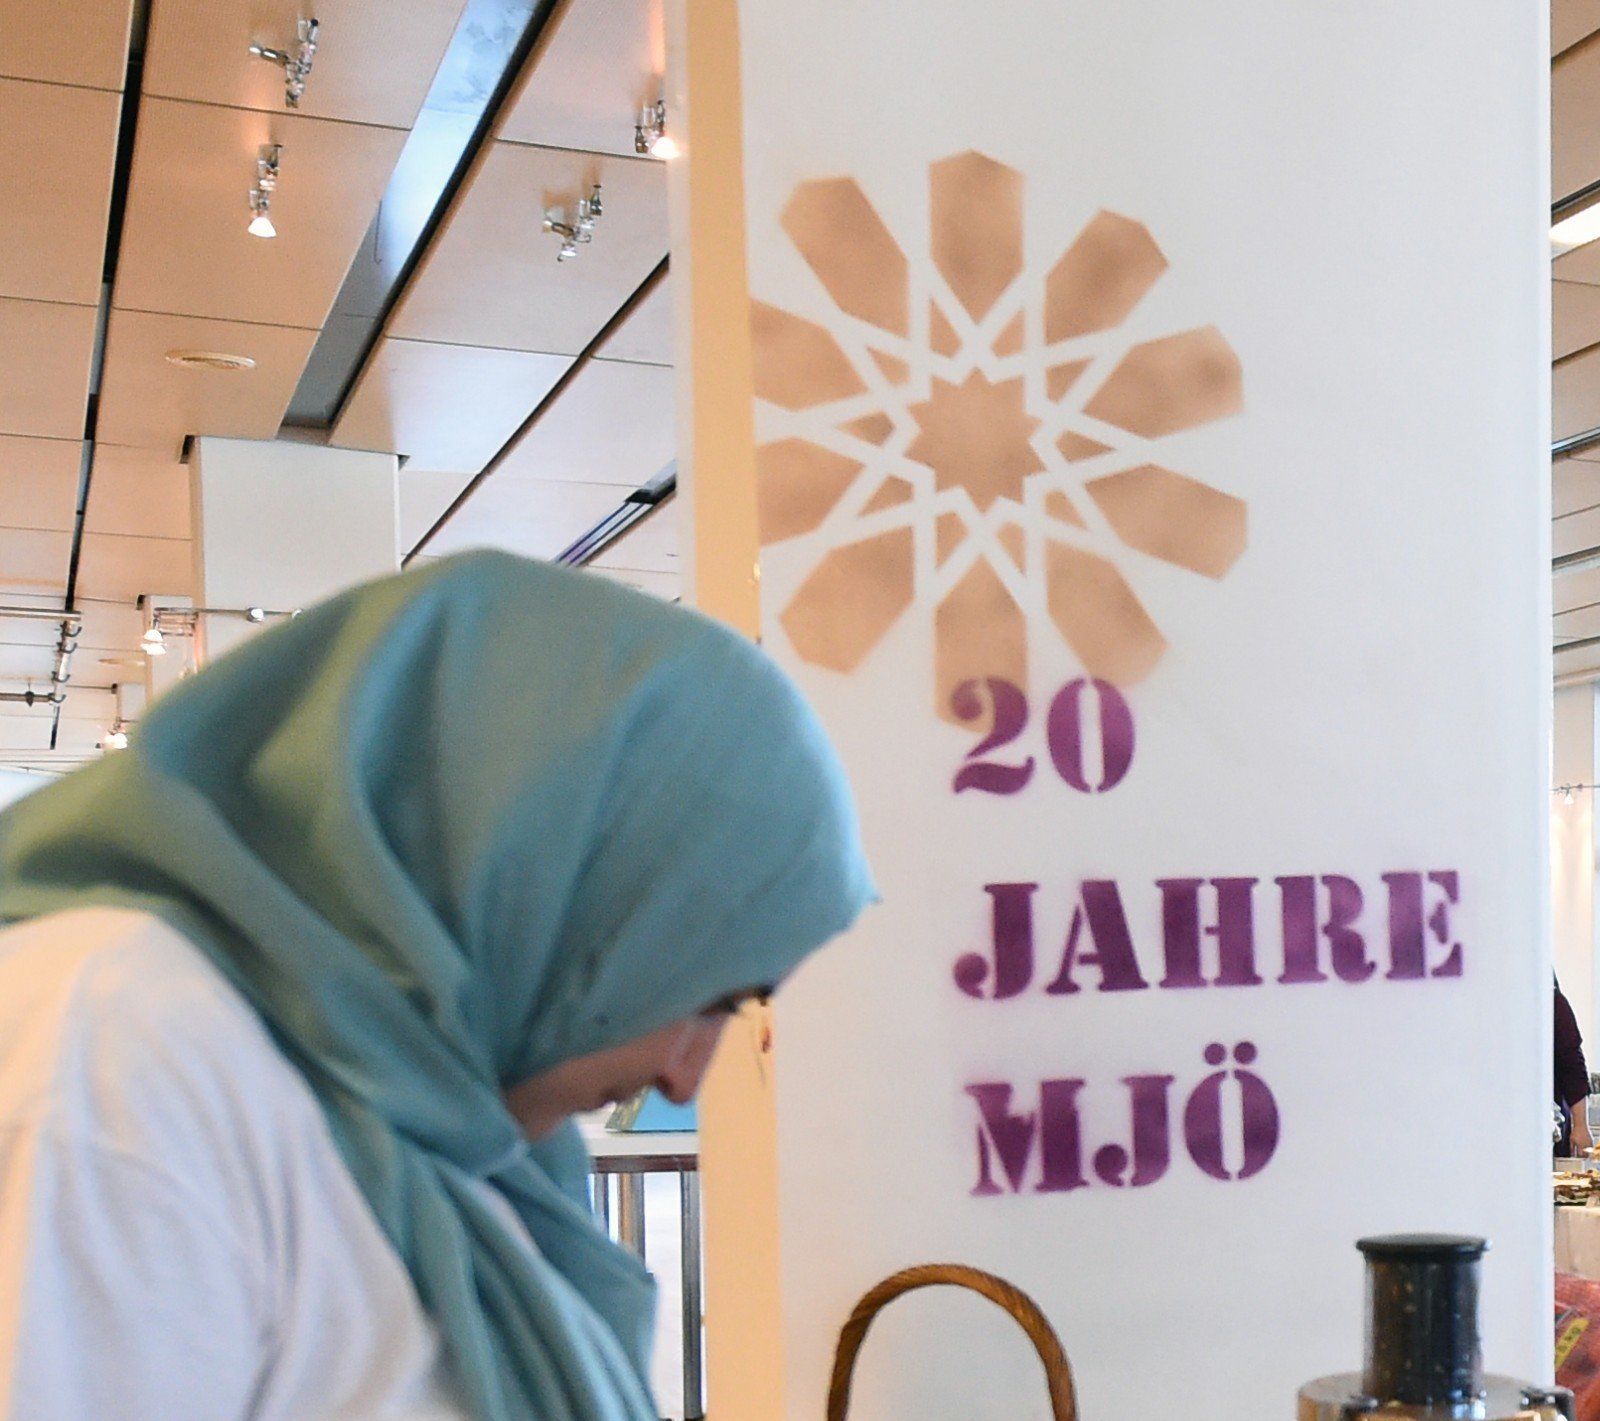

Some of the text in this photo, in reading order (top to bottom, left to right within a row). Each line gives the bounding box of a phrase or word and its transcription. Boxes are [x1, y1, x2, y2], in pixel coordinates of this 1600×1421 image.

[951, 676, 1136, 795] 20
[953, 870, 1464, 1000] JAHRE
[964, 1041, 1280, 1196] MJÖ
